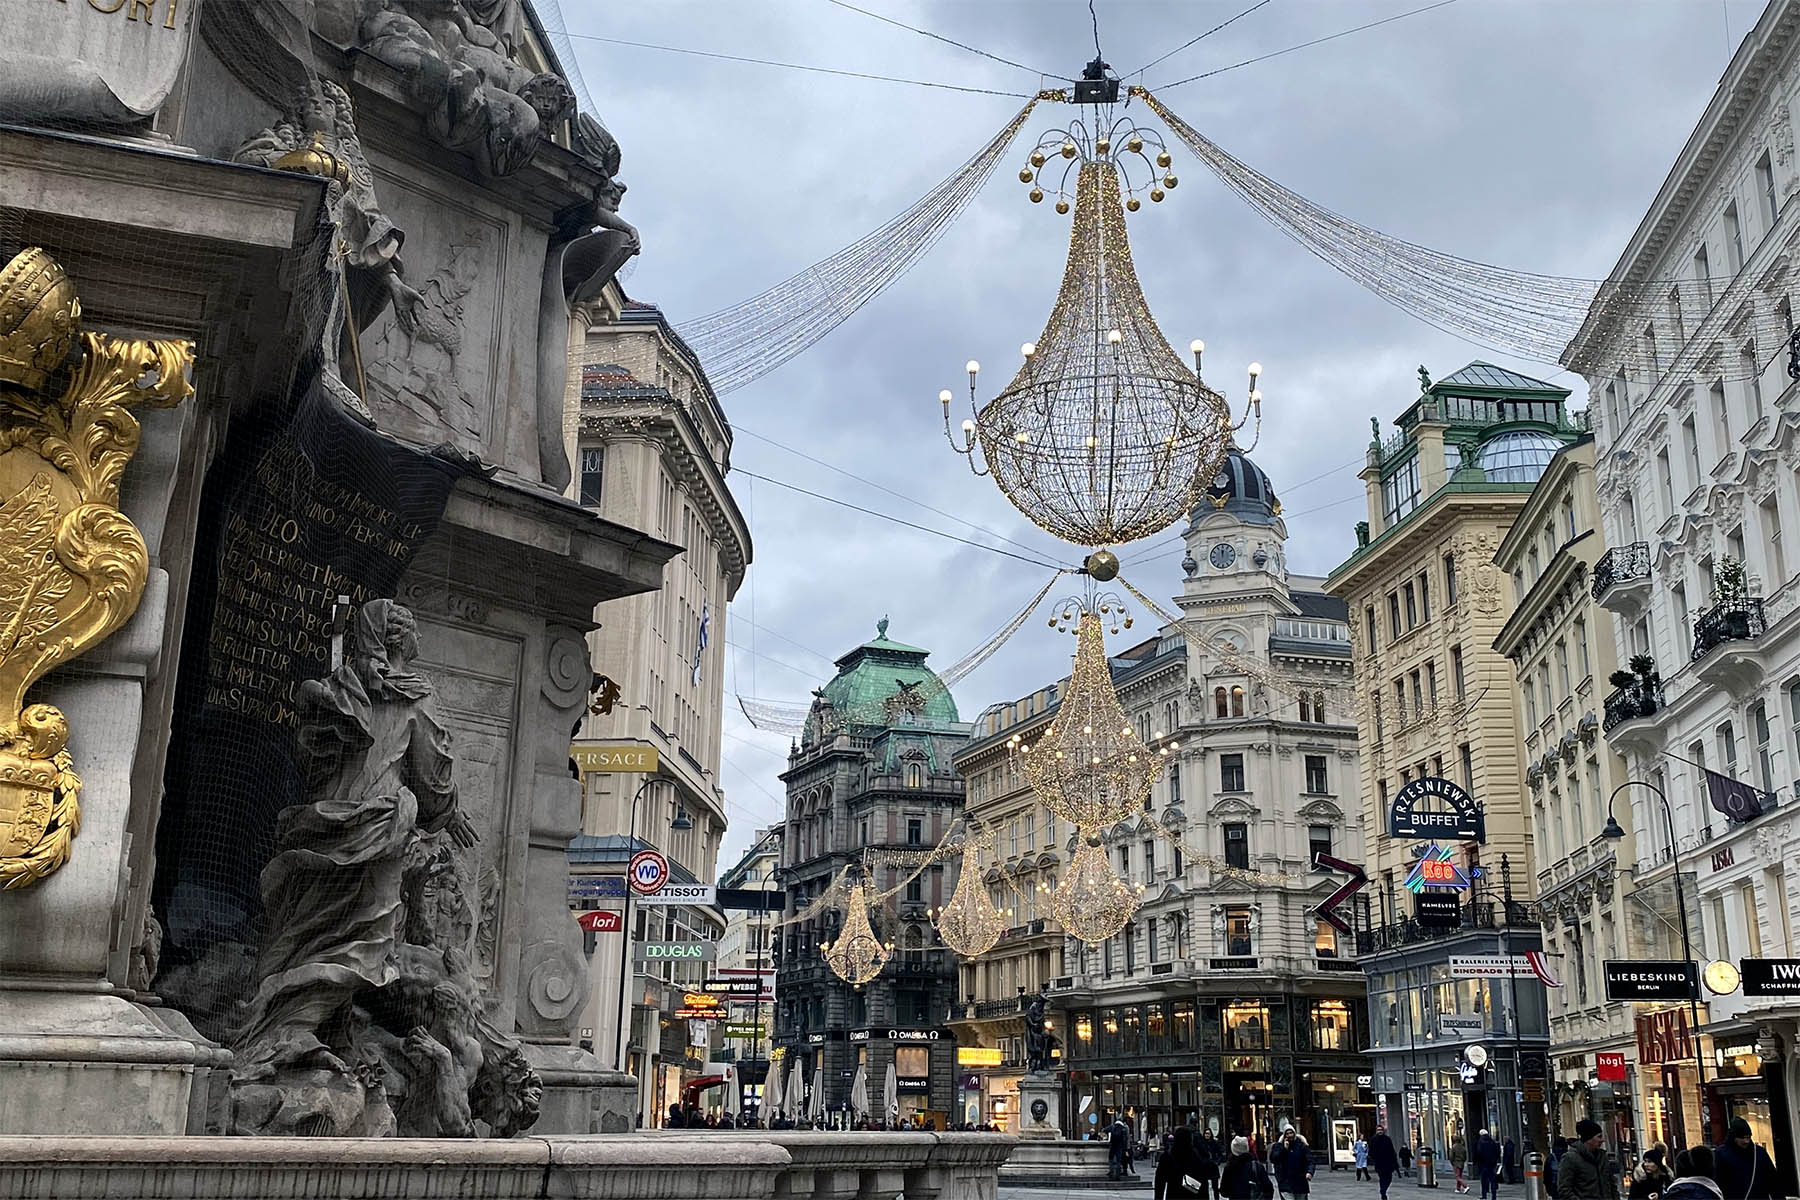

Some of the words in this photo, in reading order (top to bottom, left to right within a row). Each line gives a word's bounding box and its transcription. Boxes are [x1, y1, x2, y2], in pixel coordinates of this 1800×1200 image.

[1411, 814, 1460, 826] BUFFET
[1711, 847, 1735, 872] LISKA
[638, 865, 659, 879] VVD
[662, 887, 708, 897] TISSOT
[646, 945, 702, 957] DOUGLAS
[1609, 973, 1686, 982] LIEBESKIND
[899, 1031, 928, 1040] OMEGA
[1635, 1006, 1696, 1065] LISKA
[1599, 1056, 1623, 1066] högl
